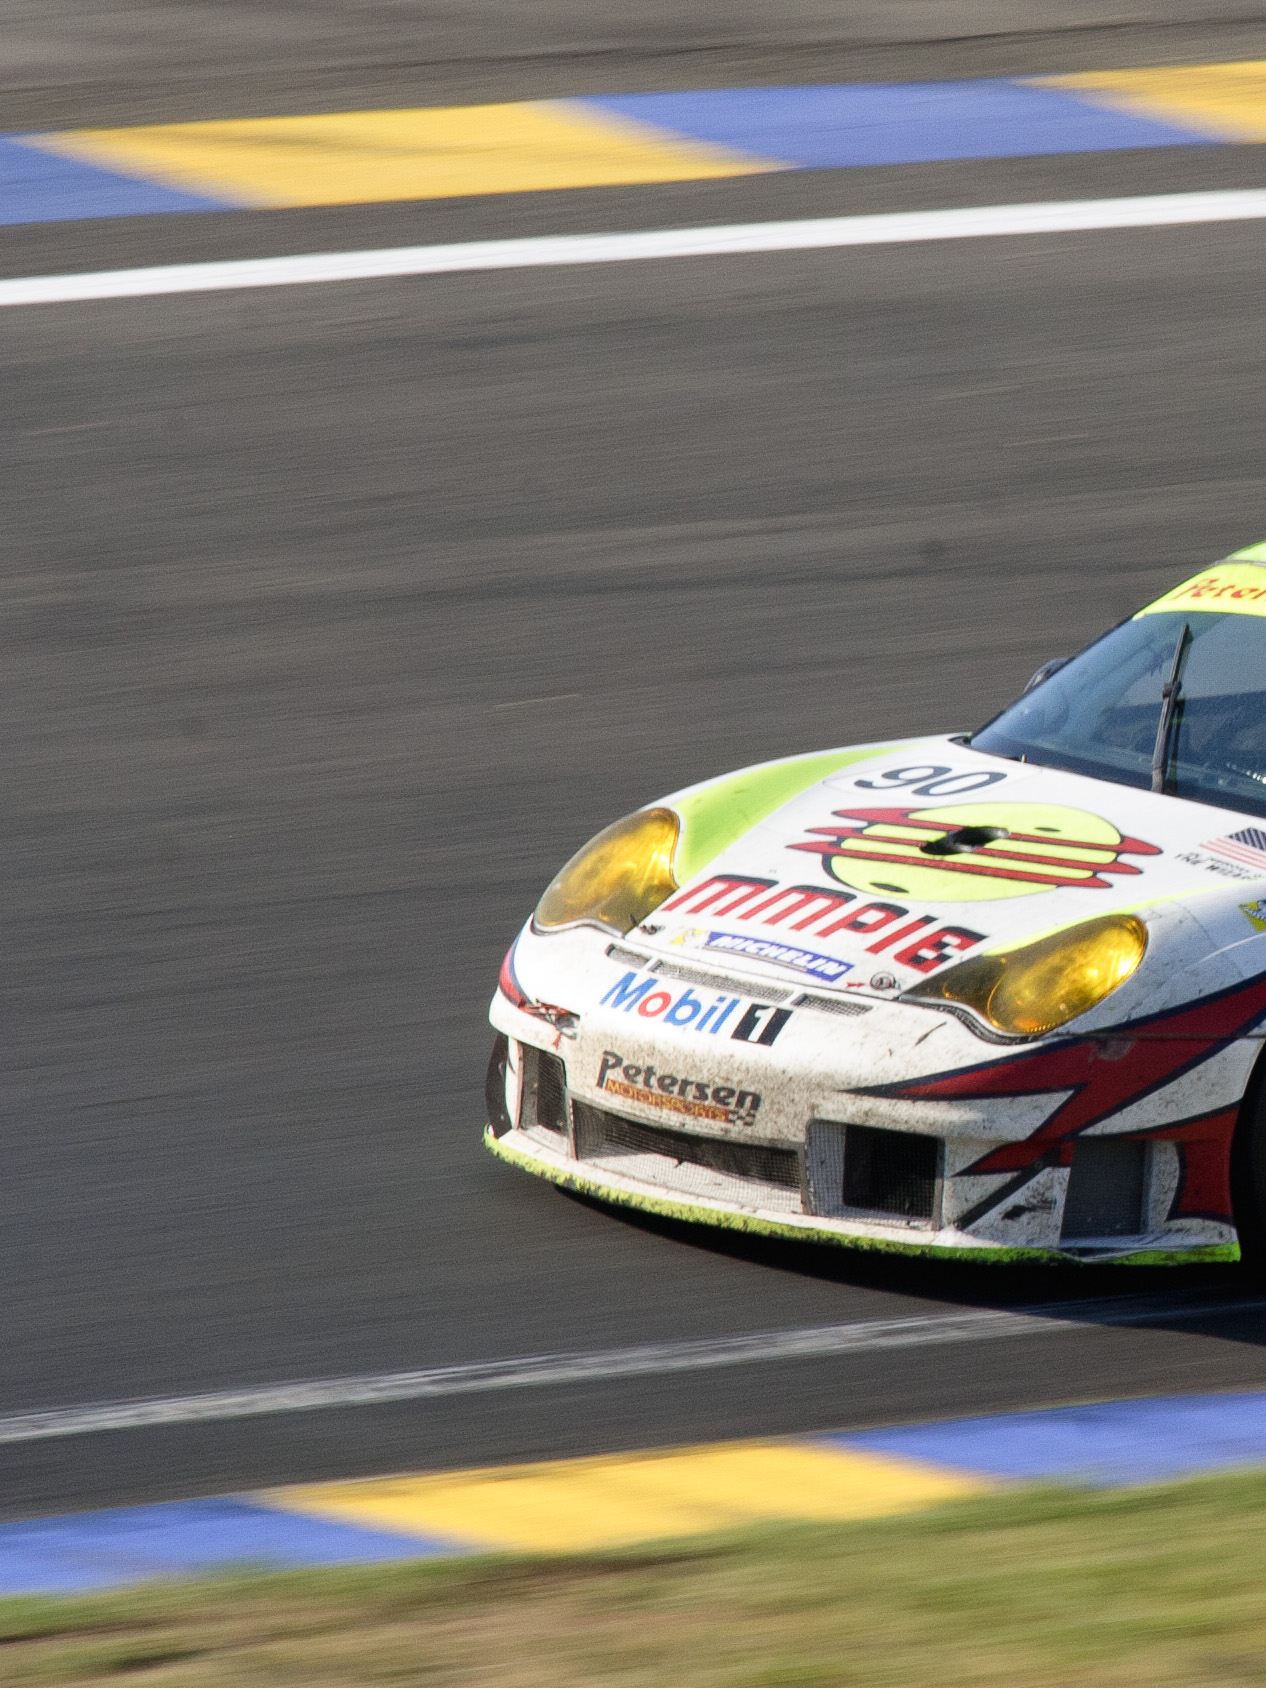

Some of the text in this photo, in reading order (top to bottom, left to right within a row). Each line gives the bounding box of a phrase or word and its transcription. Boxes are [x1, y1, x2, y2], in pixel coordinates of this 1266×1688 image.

[853, 765, 1008, 797] 90
[708, 935, 850, 978] MICHELIN
[599, 971, 741, 1035] Mobil
[596, 1049, 762, 1112] Petersen
